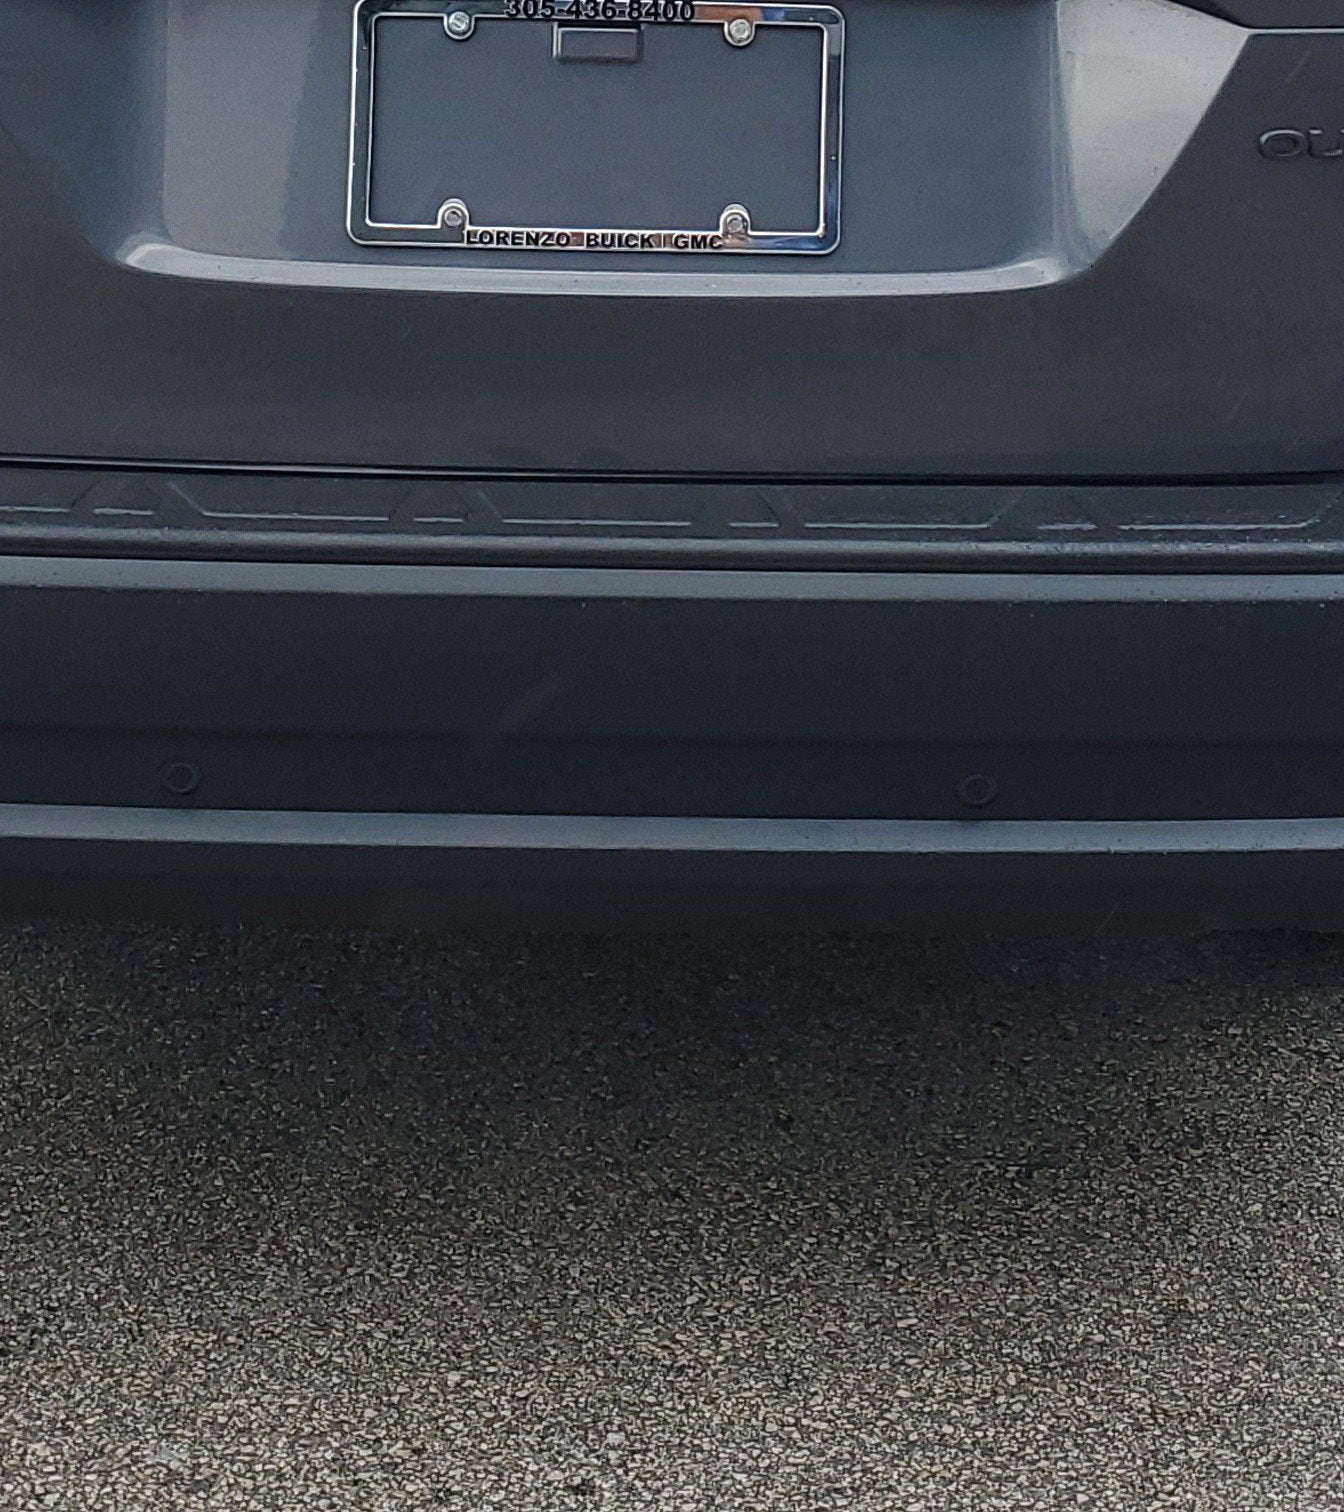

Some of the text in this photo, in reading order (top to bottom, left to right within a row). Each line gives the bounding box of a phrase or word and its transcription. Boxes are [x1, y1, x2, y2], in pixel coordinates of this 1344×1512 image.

[466, 229, 724, 251] LORENZO BUICK GMC
